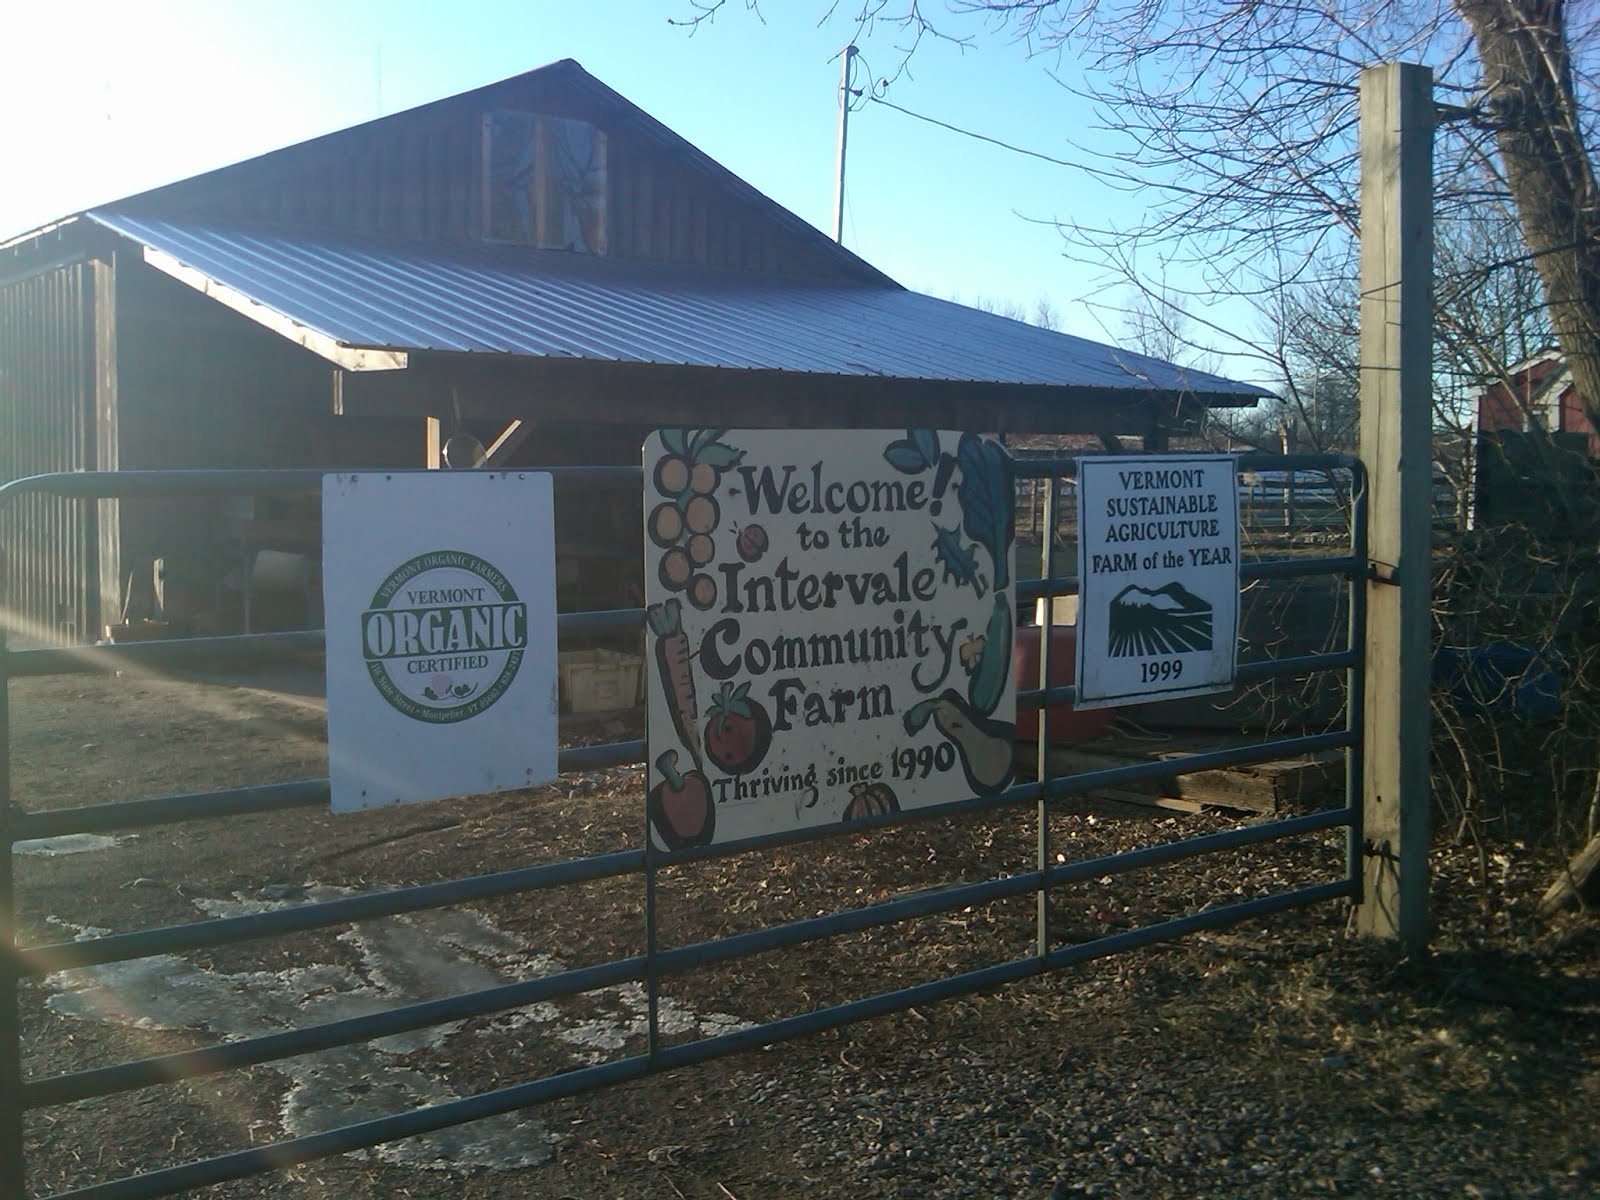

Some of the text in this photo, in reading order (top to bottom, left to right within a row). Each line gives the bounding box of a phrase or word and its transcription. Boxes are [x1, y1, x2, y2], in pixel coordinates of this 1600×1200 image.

[738, 453, 956, 517] Welcome!
[1119, 469, 1205, 491] VERMONT
[1106, 494, 1218, 518] SUSTAINABLE
[796, 516, 890, 551] to the
[1105, 519, 1220, 543] AGRICULTURE
[1092, 546, 1232, 574] FARM of the YEAR
[382, 554, 507, 598] VERMONT ORGANIC FARMERS
[718, 551, 937, 615] Intervale
[407, 588, 485, 604] VERMONT
[367, 605, 523, 657] ORGANIC
[407, 656, 489, 674] CERTIFIED
[699, 609, 967, 694] Community
[1140, 659, 1183, 684] 1999
[393, 694, 415, 714] Street
[768, 677, 895, 732] Farm
[712, 741, 956, 809] Thriving since 1990
